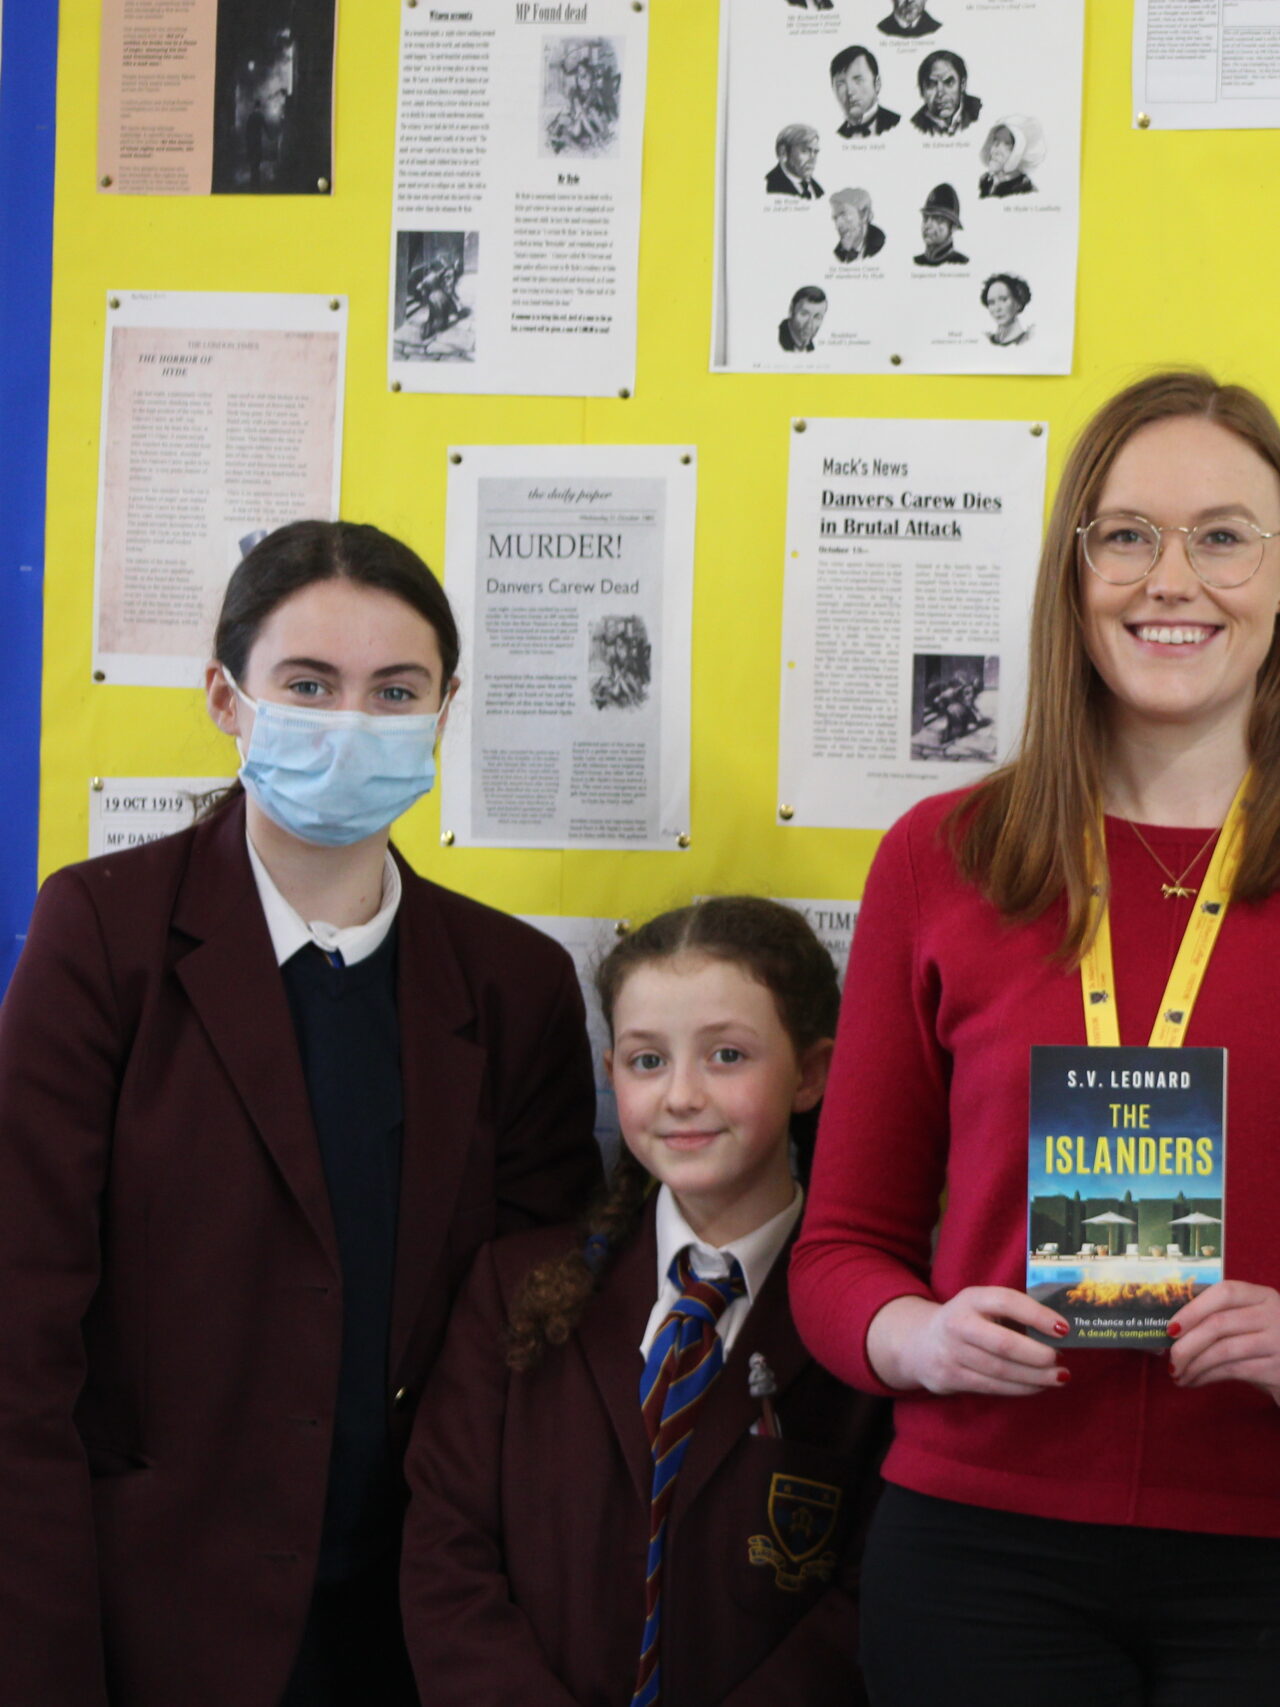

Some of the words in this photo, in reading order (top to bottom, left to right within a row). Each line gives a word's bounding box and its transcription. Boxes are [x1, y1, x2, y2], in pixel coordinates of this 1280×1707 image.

[516, 3, 530, 21] MP
[533, 3, 561, 21] Found
[565, 3, 587, 21] dead
[138, 354, 155, 363] THE
[159, 354, 198, 364] HORROR
[200, 355, 213, 365] OF
[162, 368, 187, 377] HYDE
[822, 457, 868, 477] Mack's
[873, 458, 908, 477] News
[528, 488, 544, 499] the
[548, 488, 575, 503] daily
[576, 490, 612, 503] paper
[821, 490, 894, 508] Danvers
[900, 492, 956, 509] Carew
[962, 492, 1002, 510] Dies
[820, 517, 837, 535] in
[844, 518, 899, 536] Brutal
[905, 519, 962, 537] Attack
[488, 533, 622, 559] MURDER!
[486, 578, 543, 594] Danvers
[548, 578, 595, 594] Carew
[600, 579, 640, 594] Dead
[105, 797, 119, 811] 19
[123, 797, 147, 810] OCT
[152, 797, 183, 811] 1919
[107, 833, 124, 845] MP
[1067, 1070, 1103, 1088] S.V.
[1111, 1071, 1191, 1089] LEONARD
[1109, 1104, 1150, 1128] THE
[1045, 1135, 1213, 1175] ISLANDERS
[1074, 1317, 1090, 1326] The
[1092, 1317, 1124, 1326] chance
[1126, 1317, 1135, 1326] of
[1144, 1317, 1169, 1326] lifeti
[1078, 1329, 1085, 1337] A
[1087, 1329, 1118, 1339] deadly
[1119, 1330, 1168, 1339] competitio
